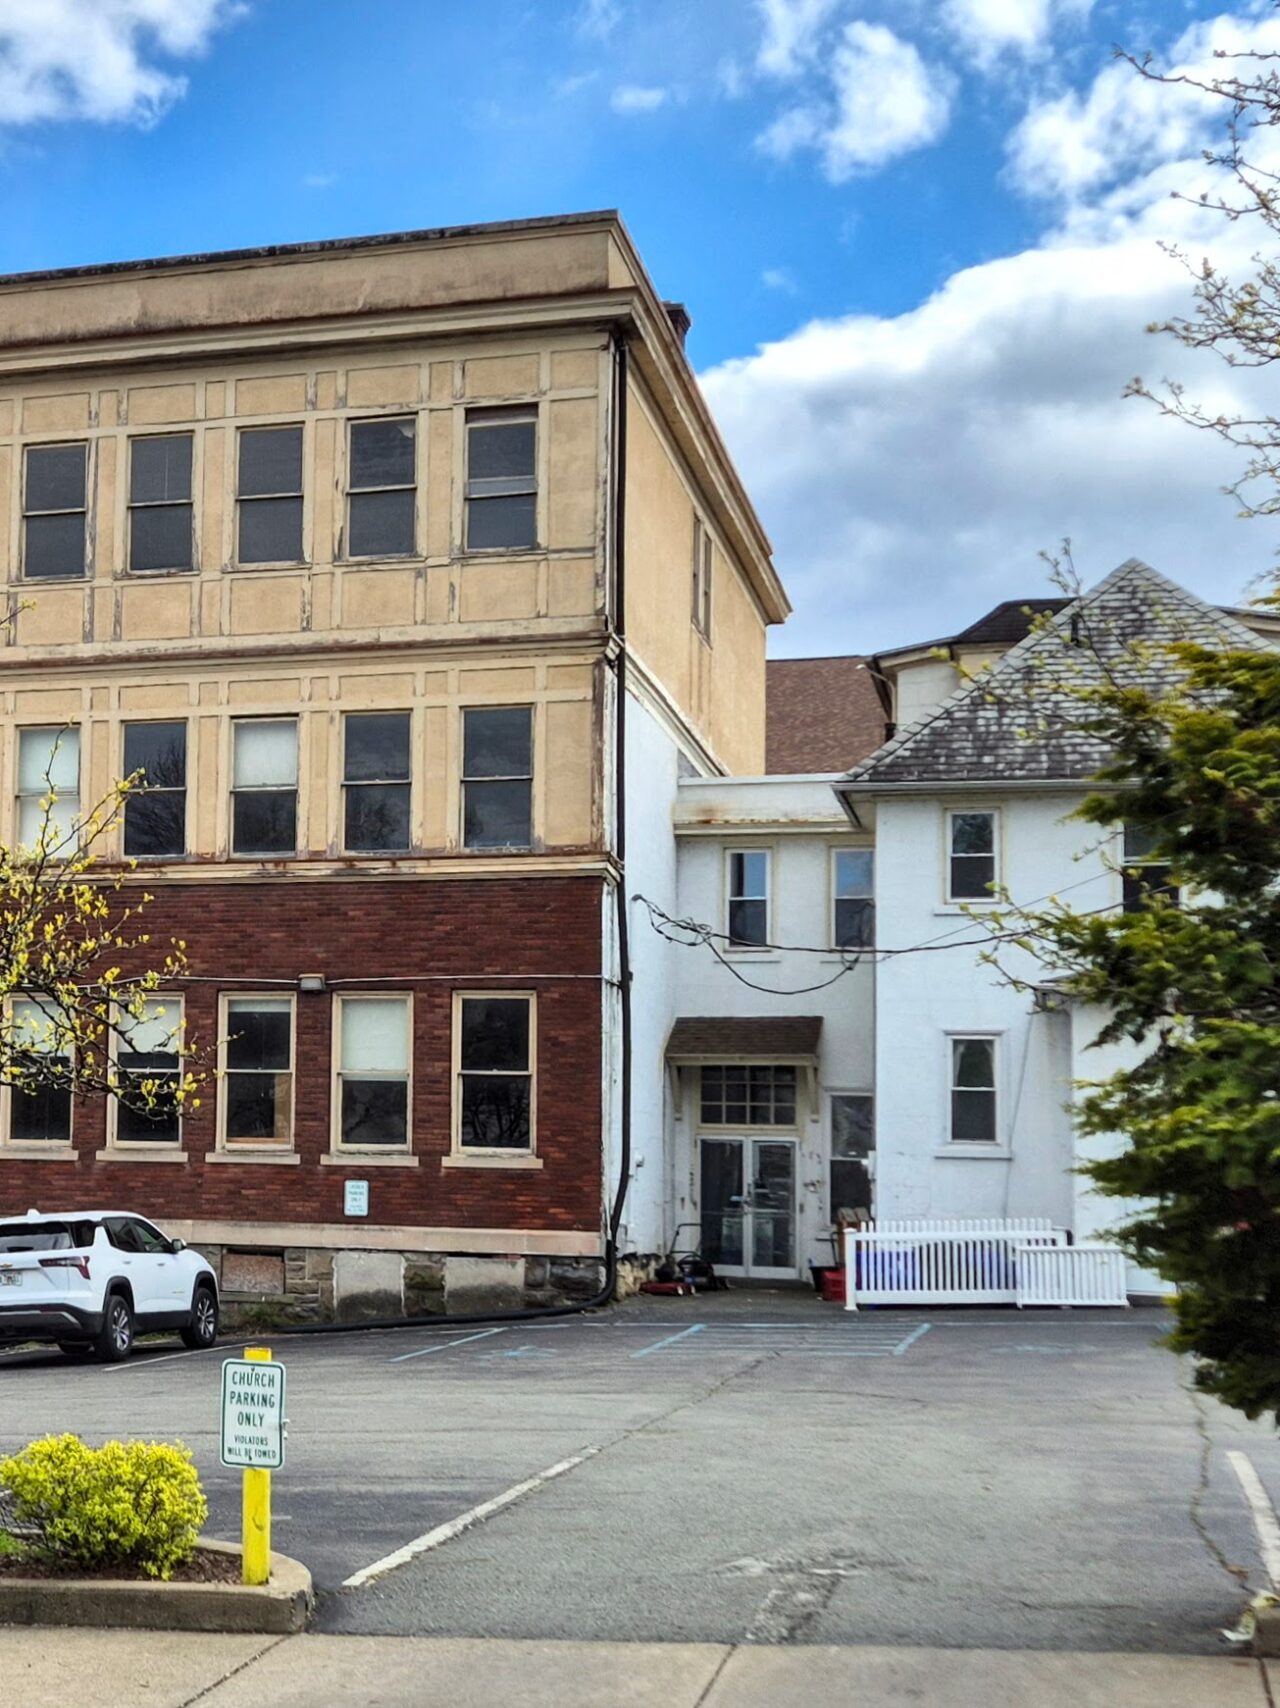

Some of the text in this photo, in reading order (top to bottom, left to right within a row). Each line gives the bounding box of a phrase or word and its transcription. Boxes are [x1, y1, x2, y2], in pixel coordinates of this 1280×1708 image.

[232, 1371, 275, 1388] CHURCH
[230, 1391, 275, 1408] PARKING
[237, 1412, 264, 1427] ONLY
[234, 1435, 268, 1446] VIOLATORS
[227, 1447, 276, 1459] WILL BE TOWED
